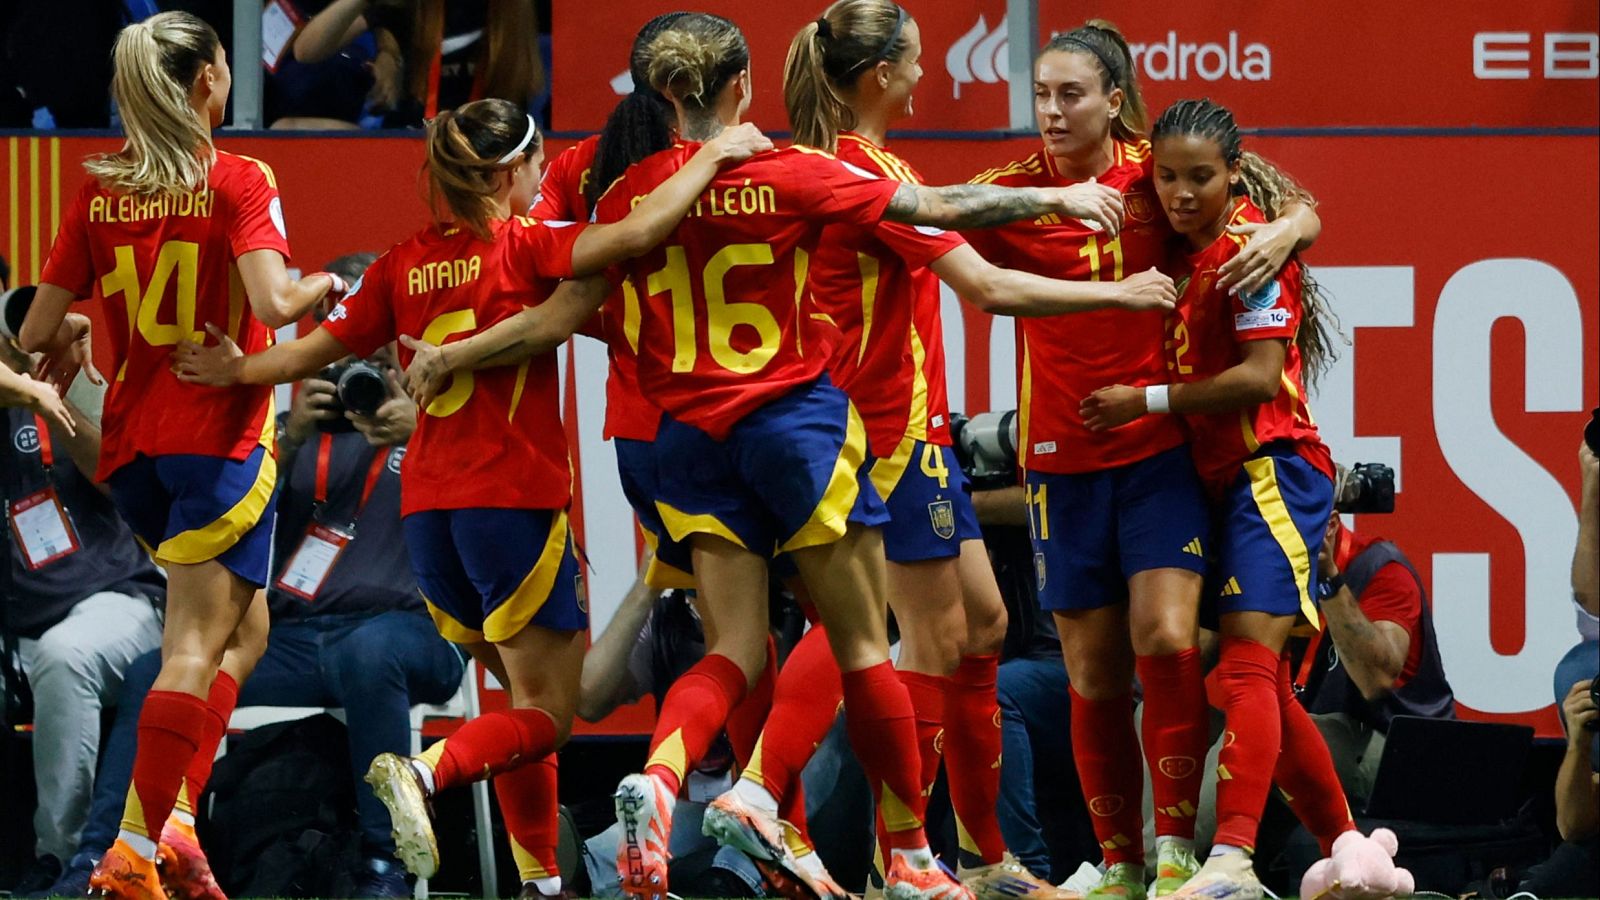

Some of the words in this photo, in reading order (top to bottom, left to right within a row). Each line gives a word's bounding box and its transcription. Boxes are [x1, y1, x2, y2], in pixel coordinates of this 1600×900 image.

[89, 189, 215, 223] ALEIXANDRI
[709, 178, 777, 216] LEÓN
[408, 255, 481, 296] AITANA
[1078, 236, 1124, 283] 11
[101, 240, 206, 383] 14
[647, 242, 783, 374] 16
[919, 443, 949, 489] 4
[1025, 484, 1049, 541] 11
